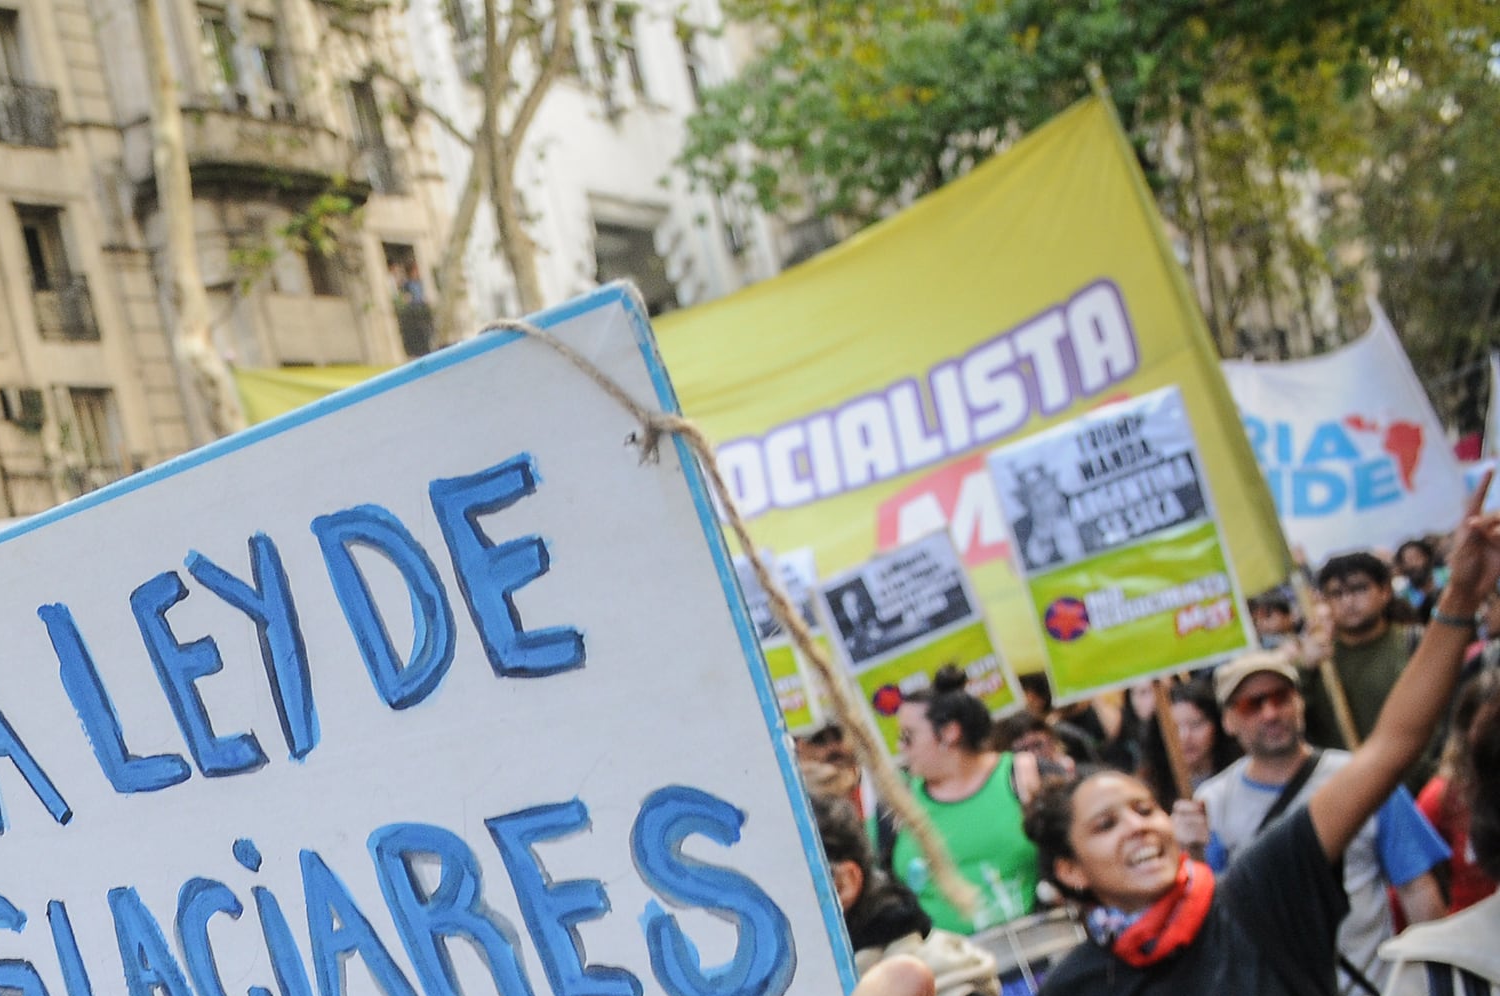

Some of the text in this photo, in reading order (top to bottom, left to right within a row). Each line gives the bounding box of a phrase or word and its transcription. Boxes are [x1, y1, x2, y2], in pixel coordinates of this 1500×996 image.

[702, 280, 1139, 525] OCIALISTA
[37, 532, 321, 793] LEY
[311, 451, 587, 711] DE
